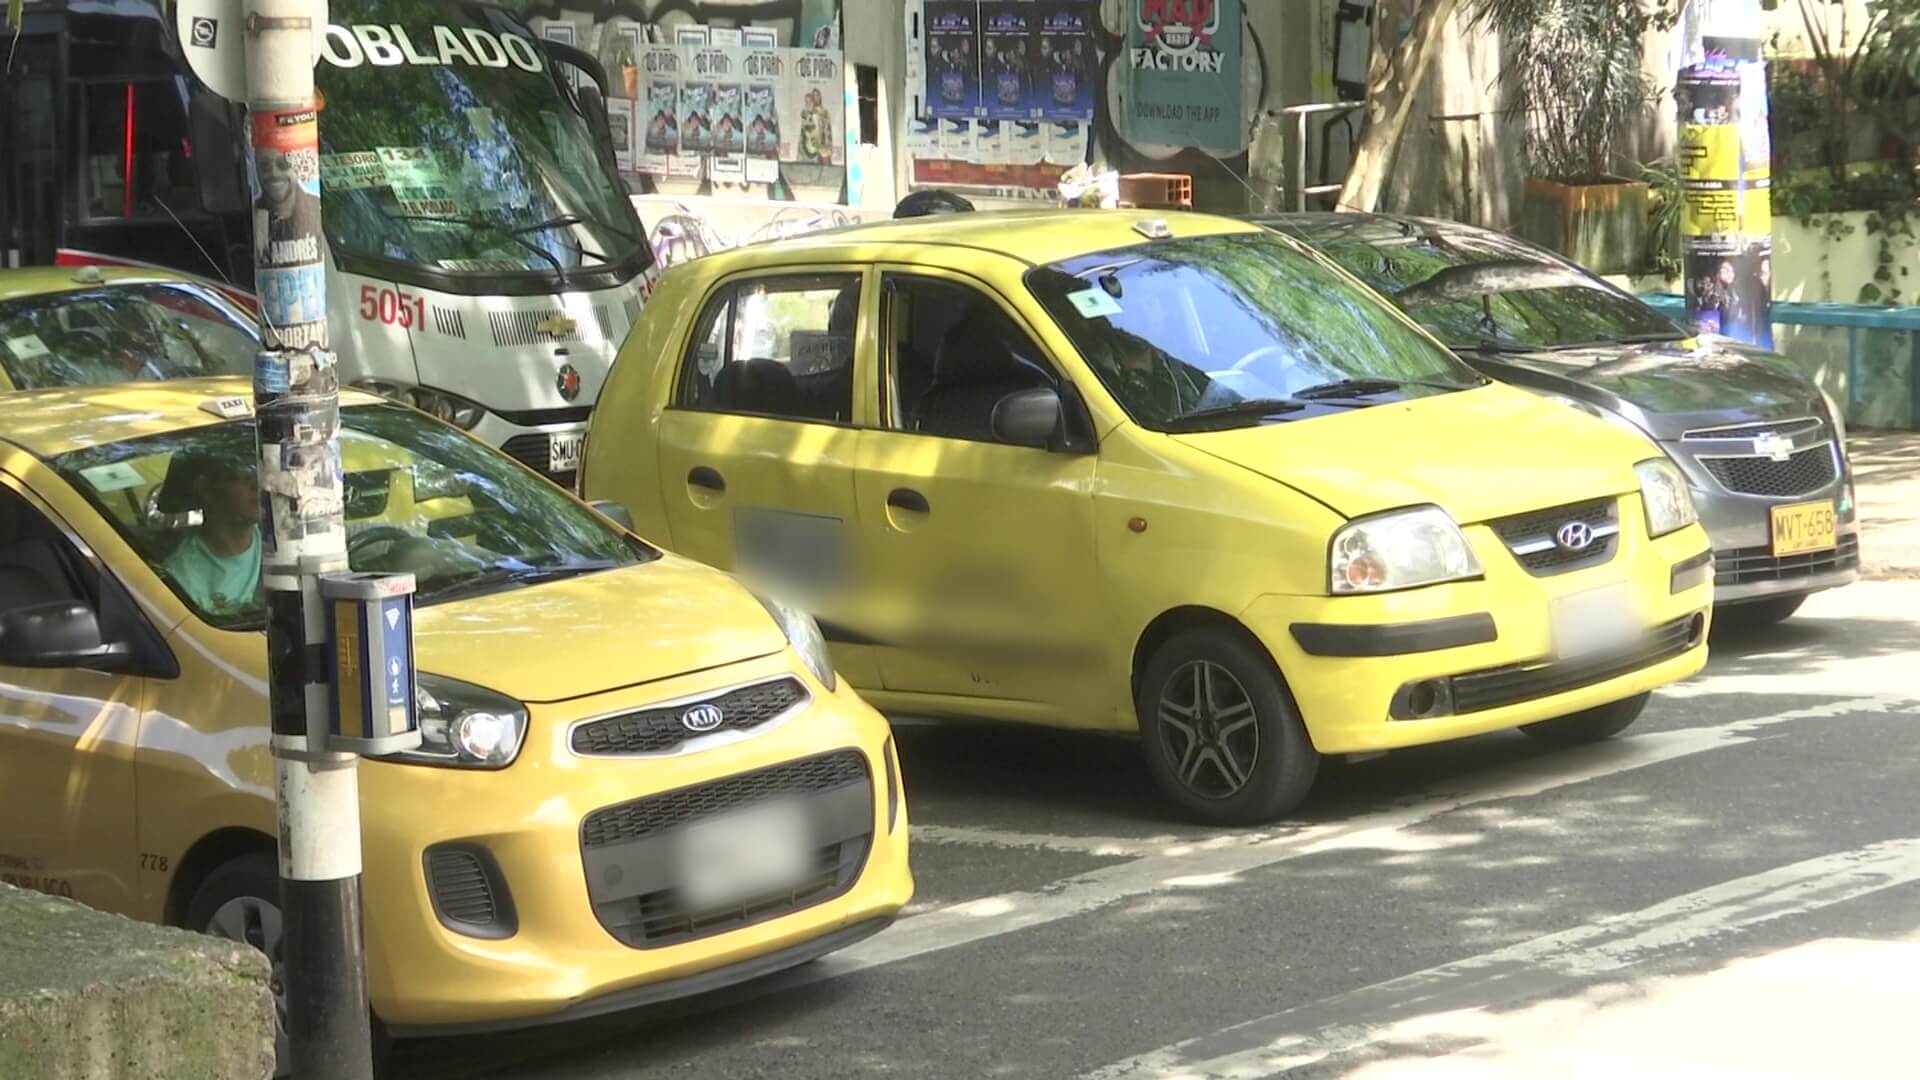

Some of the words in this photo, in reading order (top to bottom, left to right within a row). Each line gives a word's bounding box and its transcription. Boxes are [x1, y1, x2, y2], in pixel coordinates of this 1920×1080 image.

[321, 24, 543, 73] OBLADO
[1130, 48, 1225, 74] FACTORY
[1136, 102, 1184, 121] DOWNLOAD
[1186, 104, 1202, 121] THE
[1203, 104, 1220, 123] APP
[271, 233, 317, 263] ANDRÉS
[360, 285, 425, 332] 5051
[1775, 510, 1833, 542] MVT-658
[689, 708, 719, 727] KIA
[140, 853, 168, 873] 778
